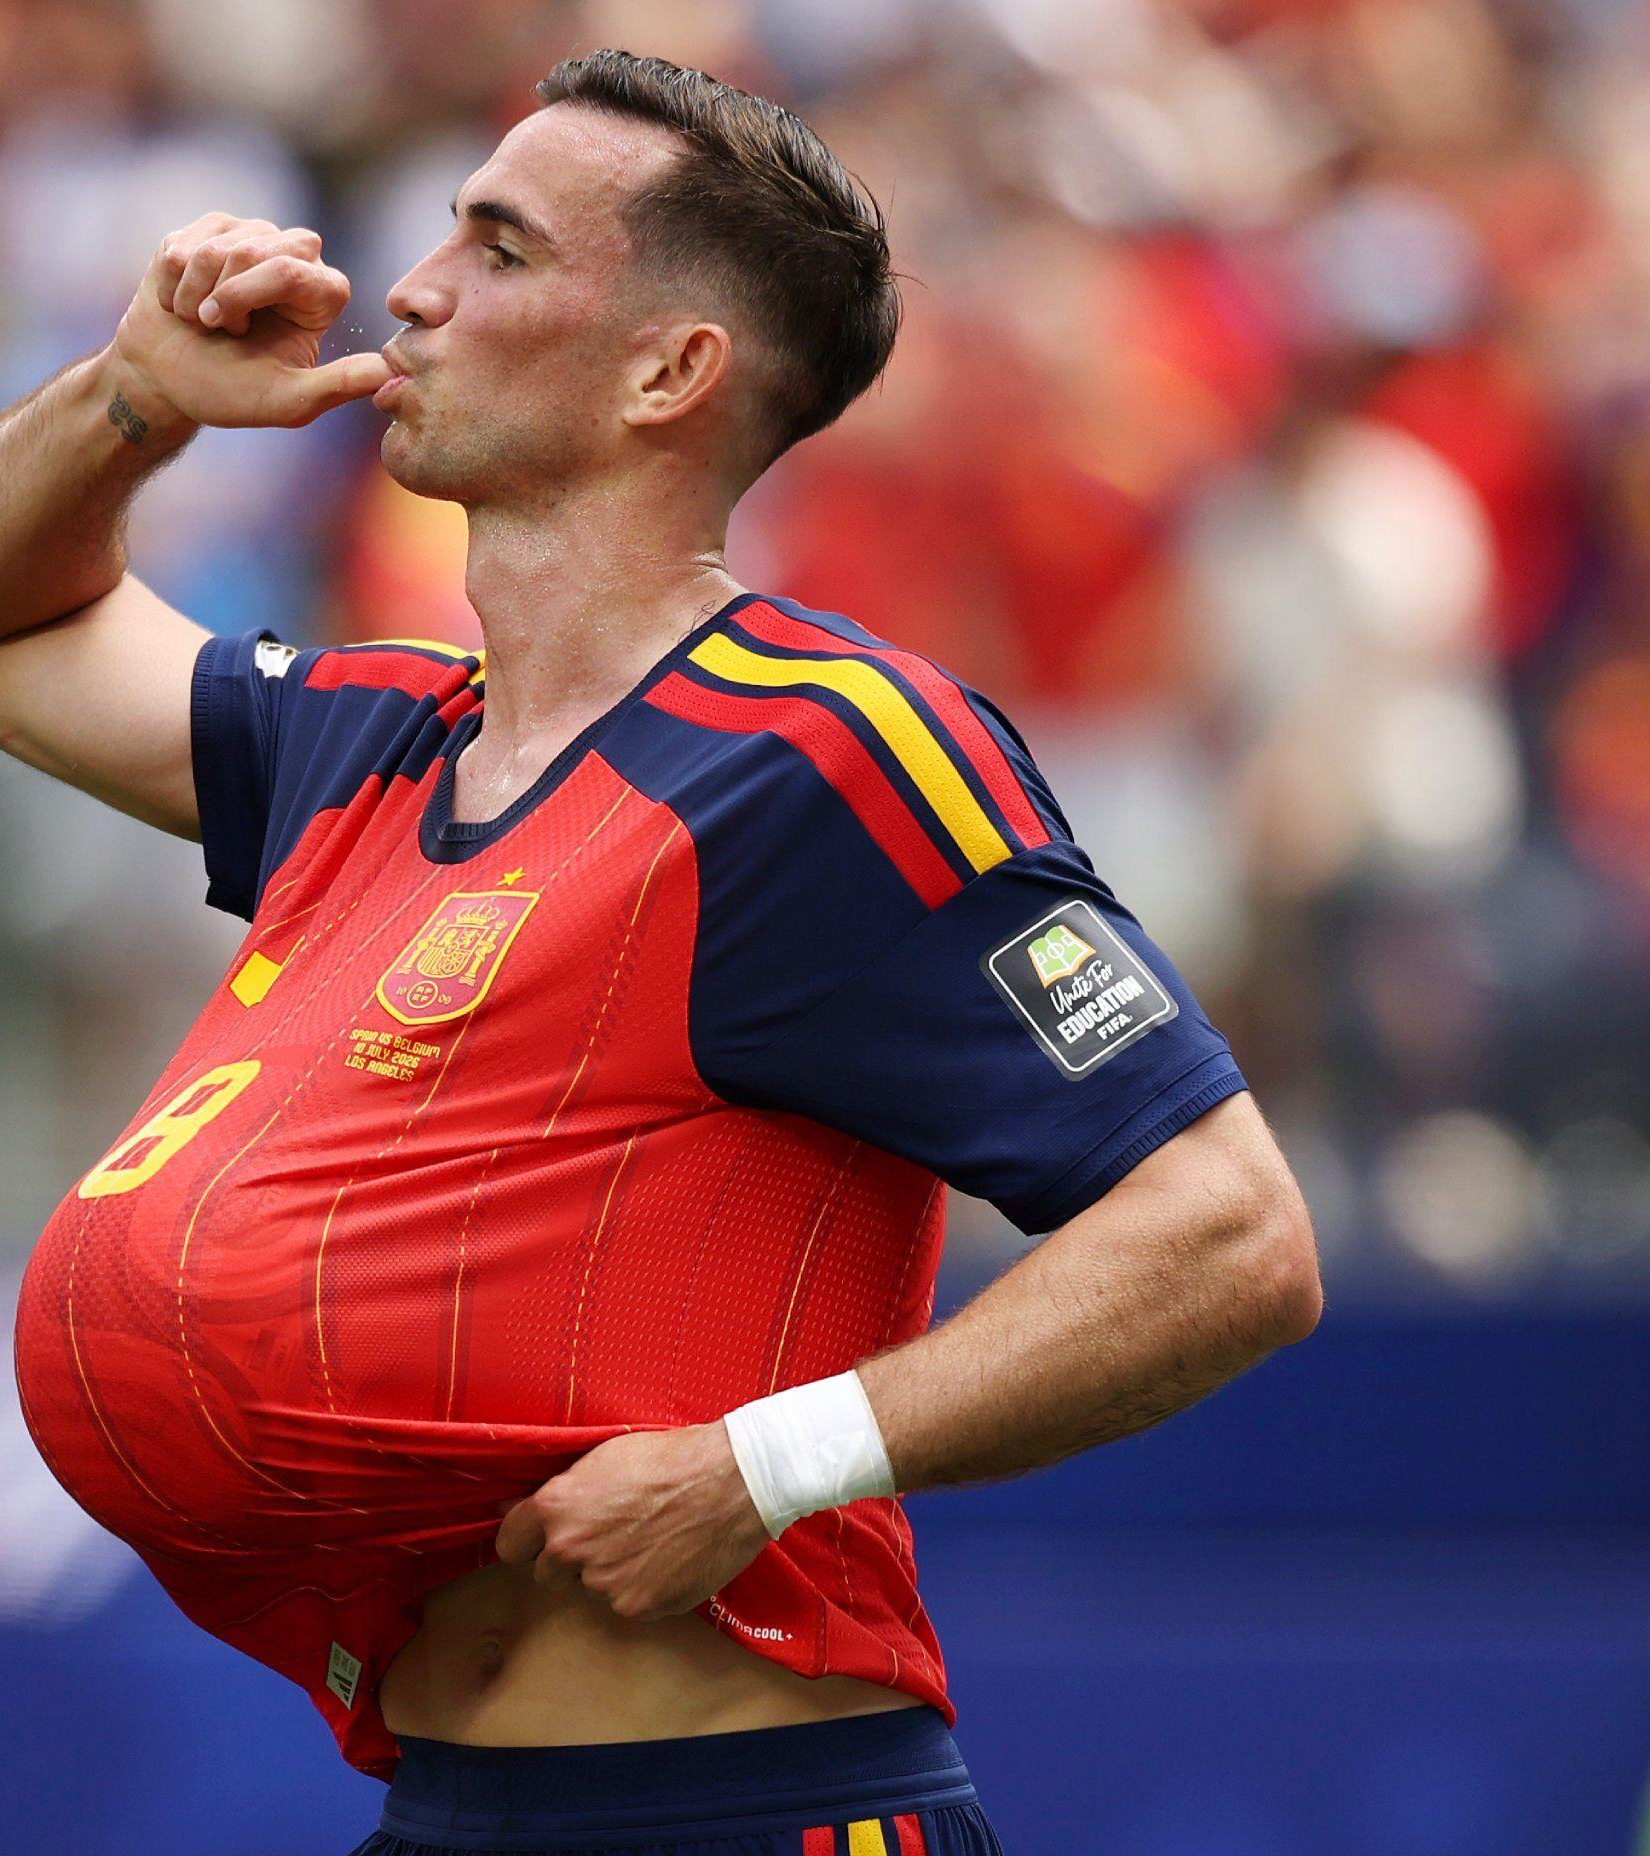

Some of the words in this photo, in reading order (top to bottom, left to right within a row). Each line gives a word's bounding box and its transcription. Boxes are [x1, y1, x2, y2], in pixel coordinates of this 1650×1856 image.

[1050, 973, 1093, 1015] Unite
[1086, 960, 1114, 988] For
[1056, 975, 1146, 1044] EDUCATION
[1096, 1012, 1131, 1040] FIFA
[365, 1043, 391, 1060] JULY
[391, 1051, 421, 1068] 2026
[393, 1036, 441, 1058] BELGIUM
[344, 1054, 366, 1070] LOS
[366, 1060, 415, 1082] ANGELES
[78, 1060, 261, 1199] 8
